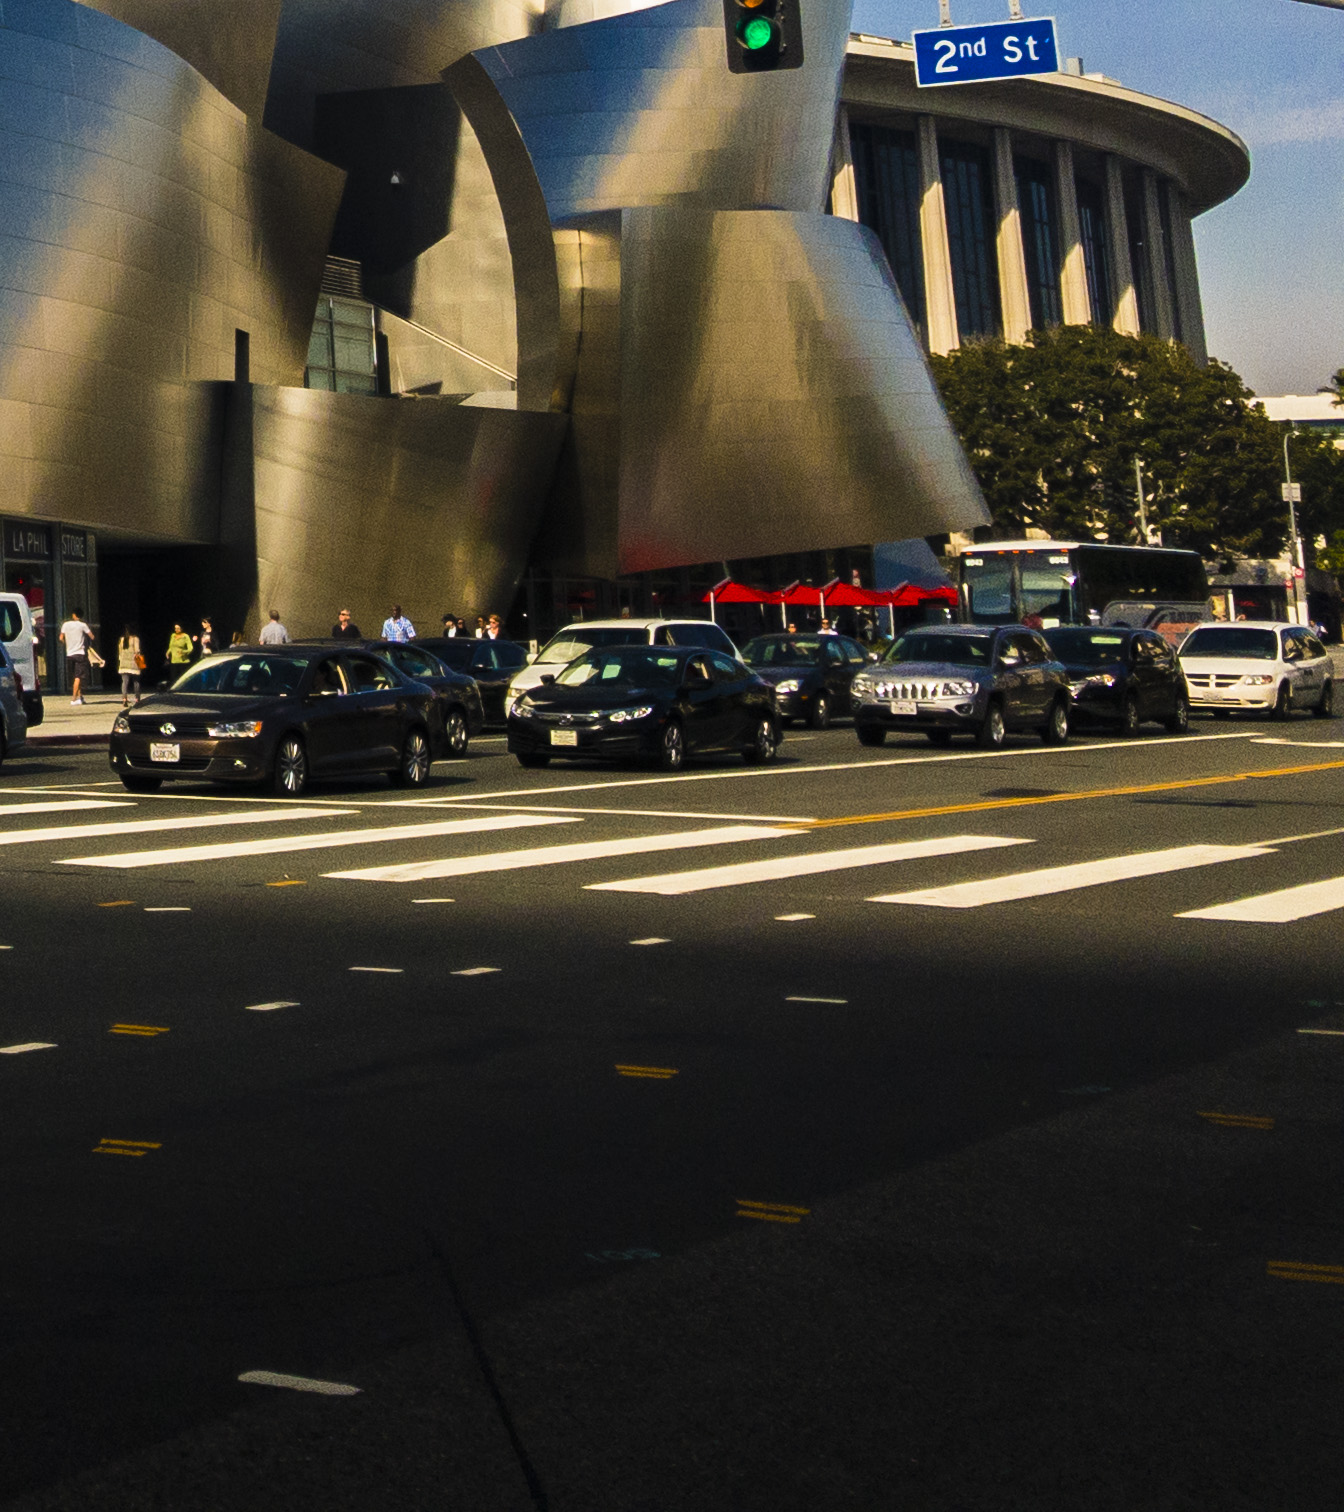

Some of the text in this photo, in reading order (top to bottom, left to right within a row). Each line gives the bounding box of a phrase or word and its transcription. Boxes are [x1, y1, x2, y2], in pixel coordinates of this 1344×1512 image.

[933, 35, 1040, 74] 2nd St
[13, 530, 85, 558] LA PHIL STORE
